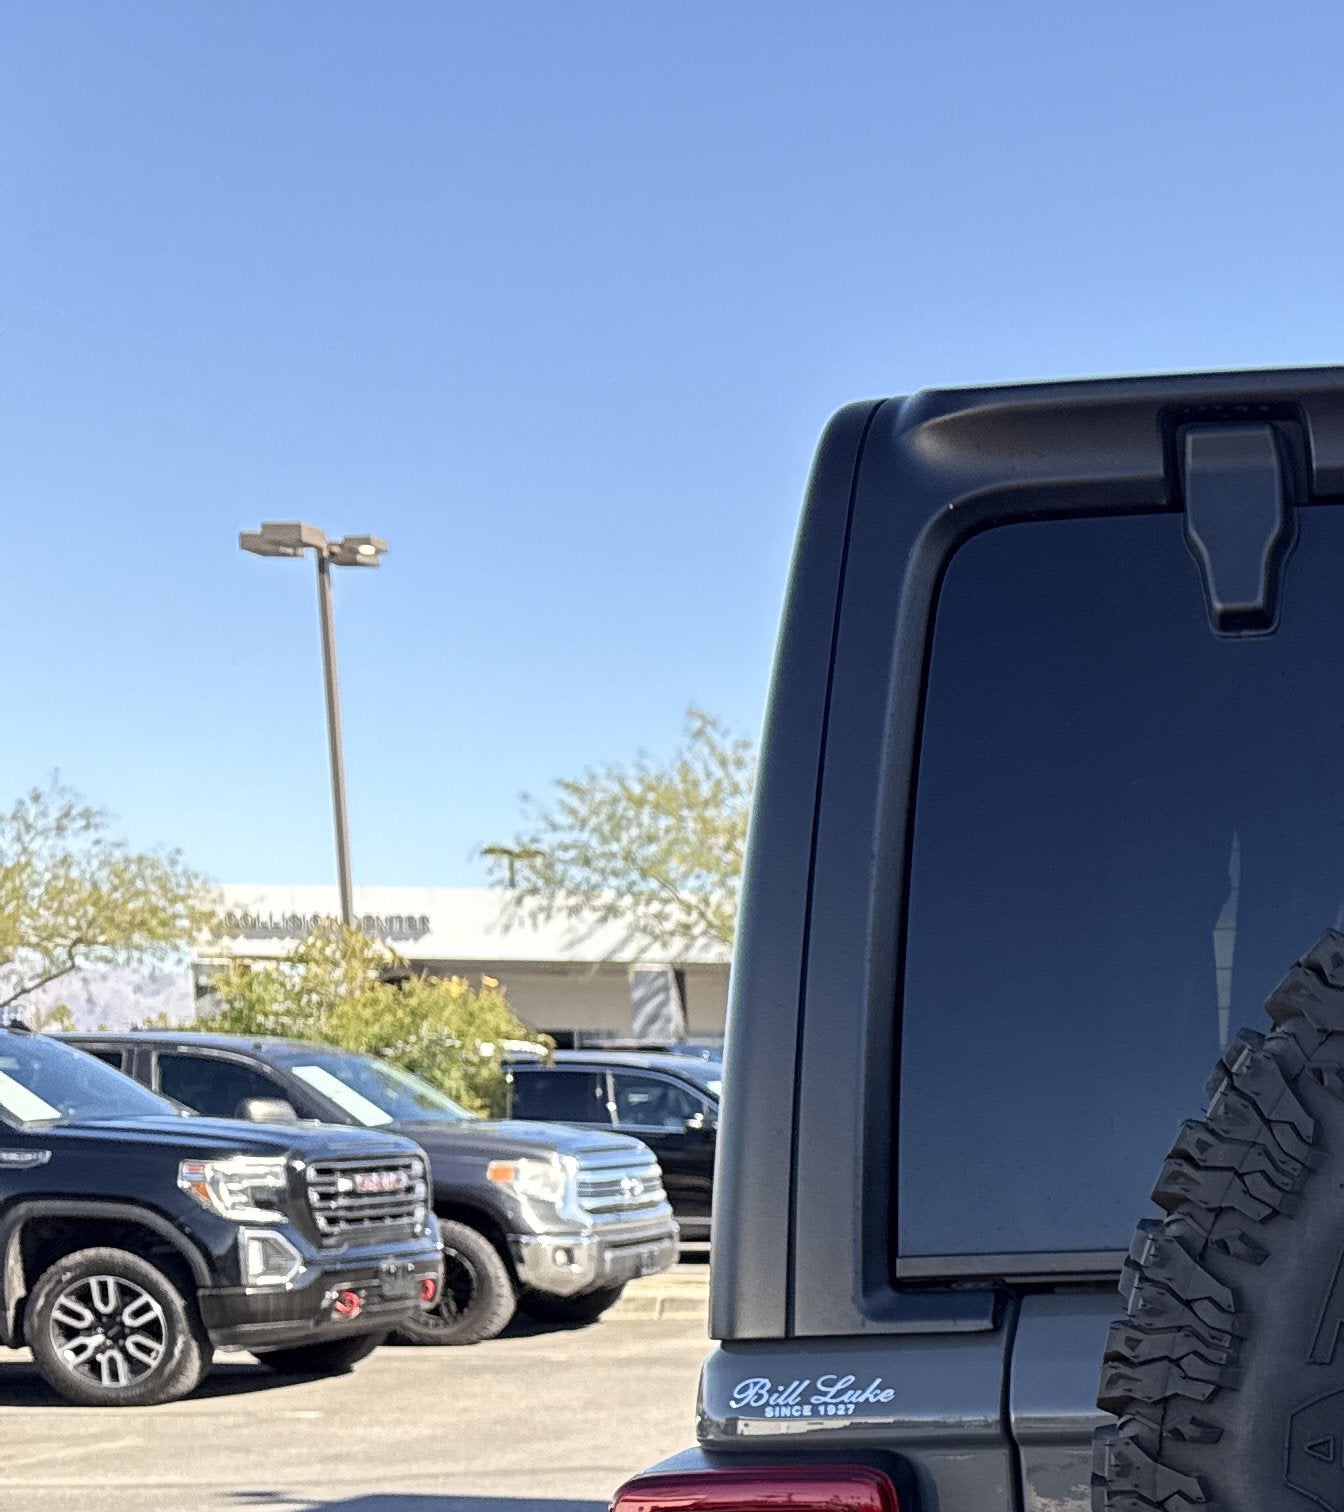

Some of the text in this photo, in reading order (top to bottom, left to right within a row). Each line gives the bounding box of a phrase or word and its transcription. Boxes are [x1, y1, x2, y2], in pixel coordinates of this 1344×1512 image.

[730, 1374, 896, 1408] Bill Luke
[764, 1403, 856, 1417] SINCE 1927
